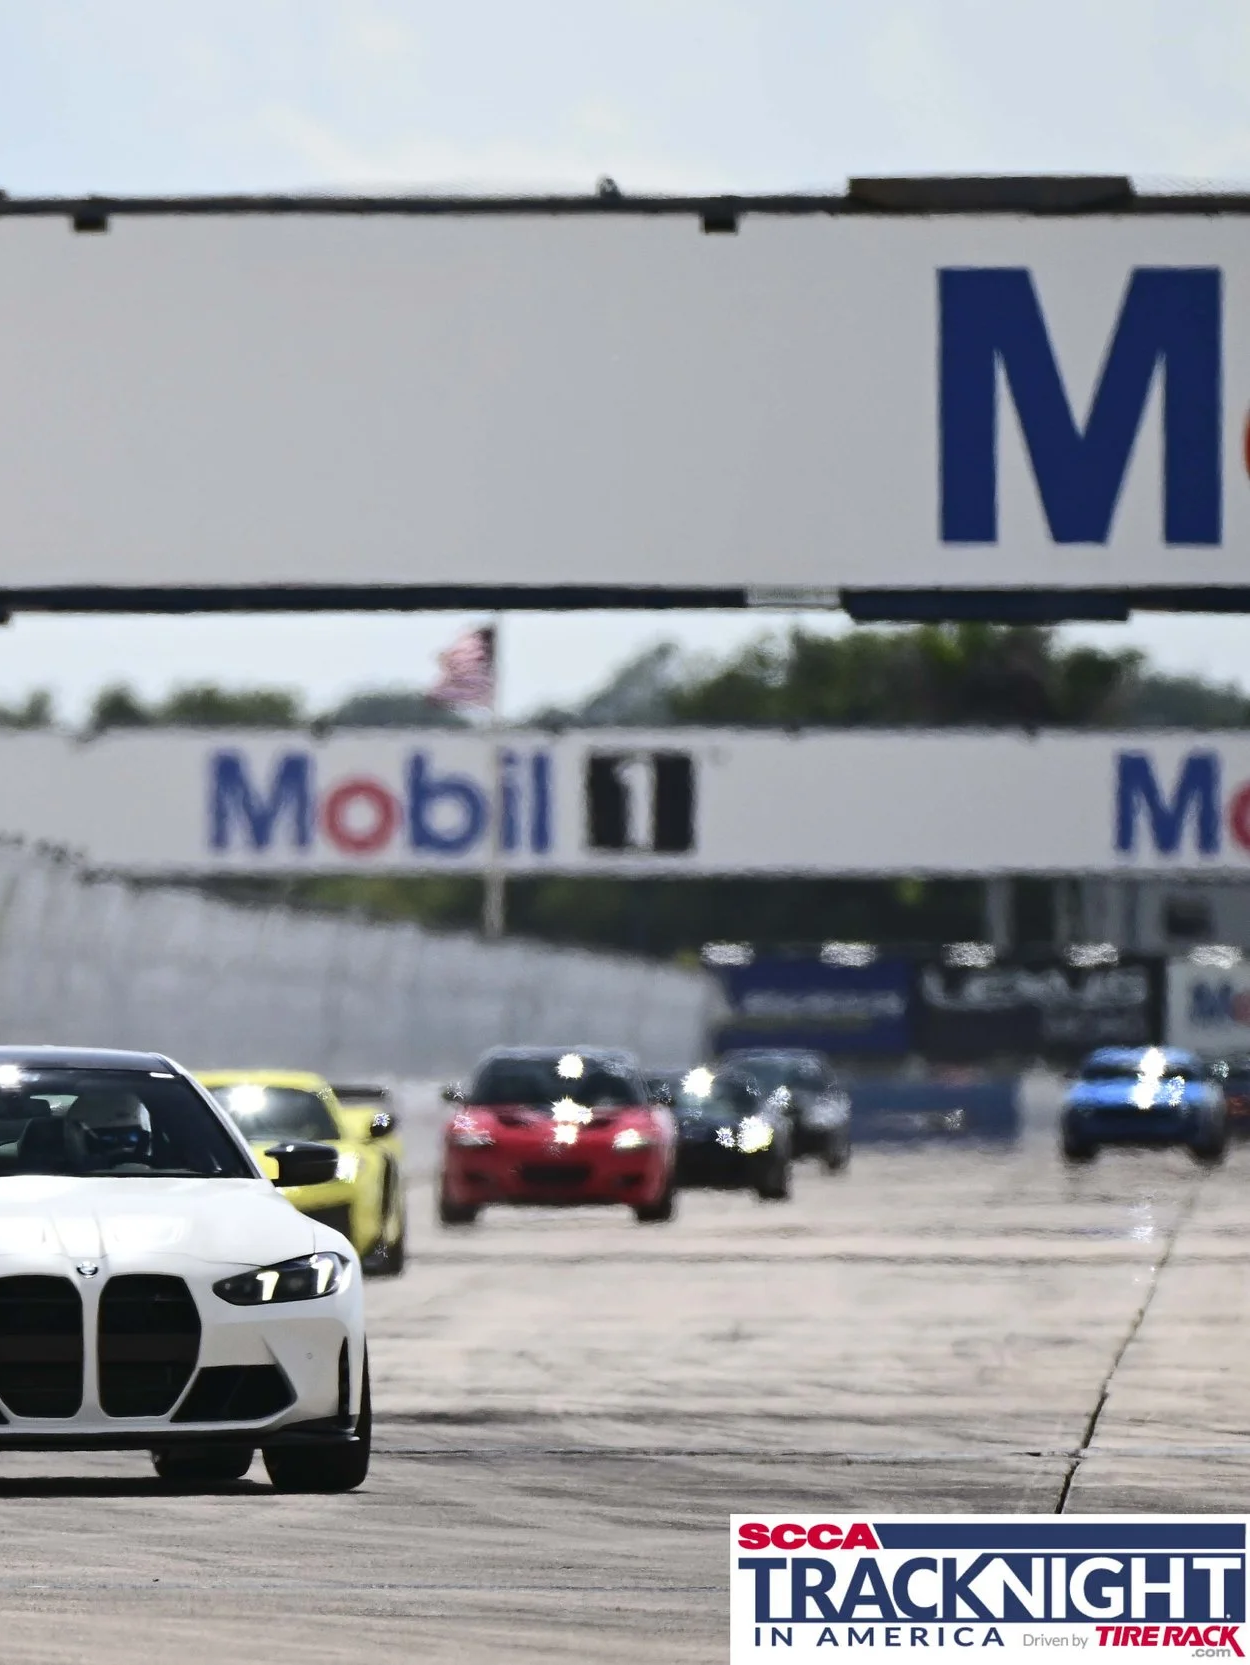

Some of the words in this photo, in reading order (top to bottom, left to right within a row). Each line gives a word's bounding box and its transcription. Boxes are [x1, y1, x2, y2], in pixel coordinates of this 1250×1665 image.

[936, 264, 1250, 549] M
[208, 748, 553, 855] Mobil
[617, 760, 654, 848] 1
[1114, 749, 1250, 857] M
